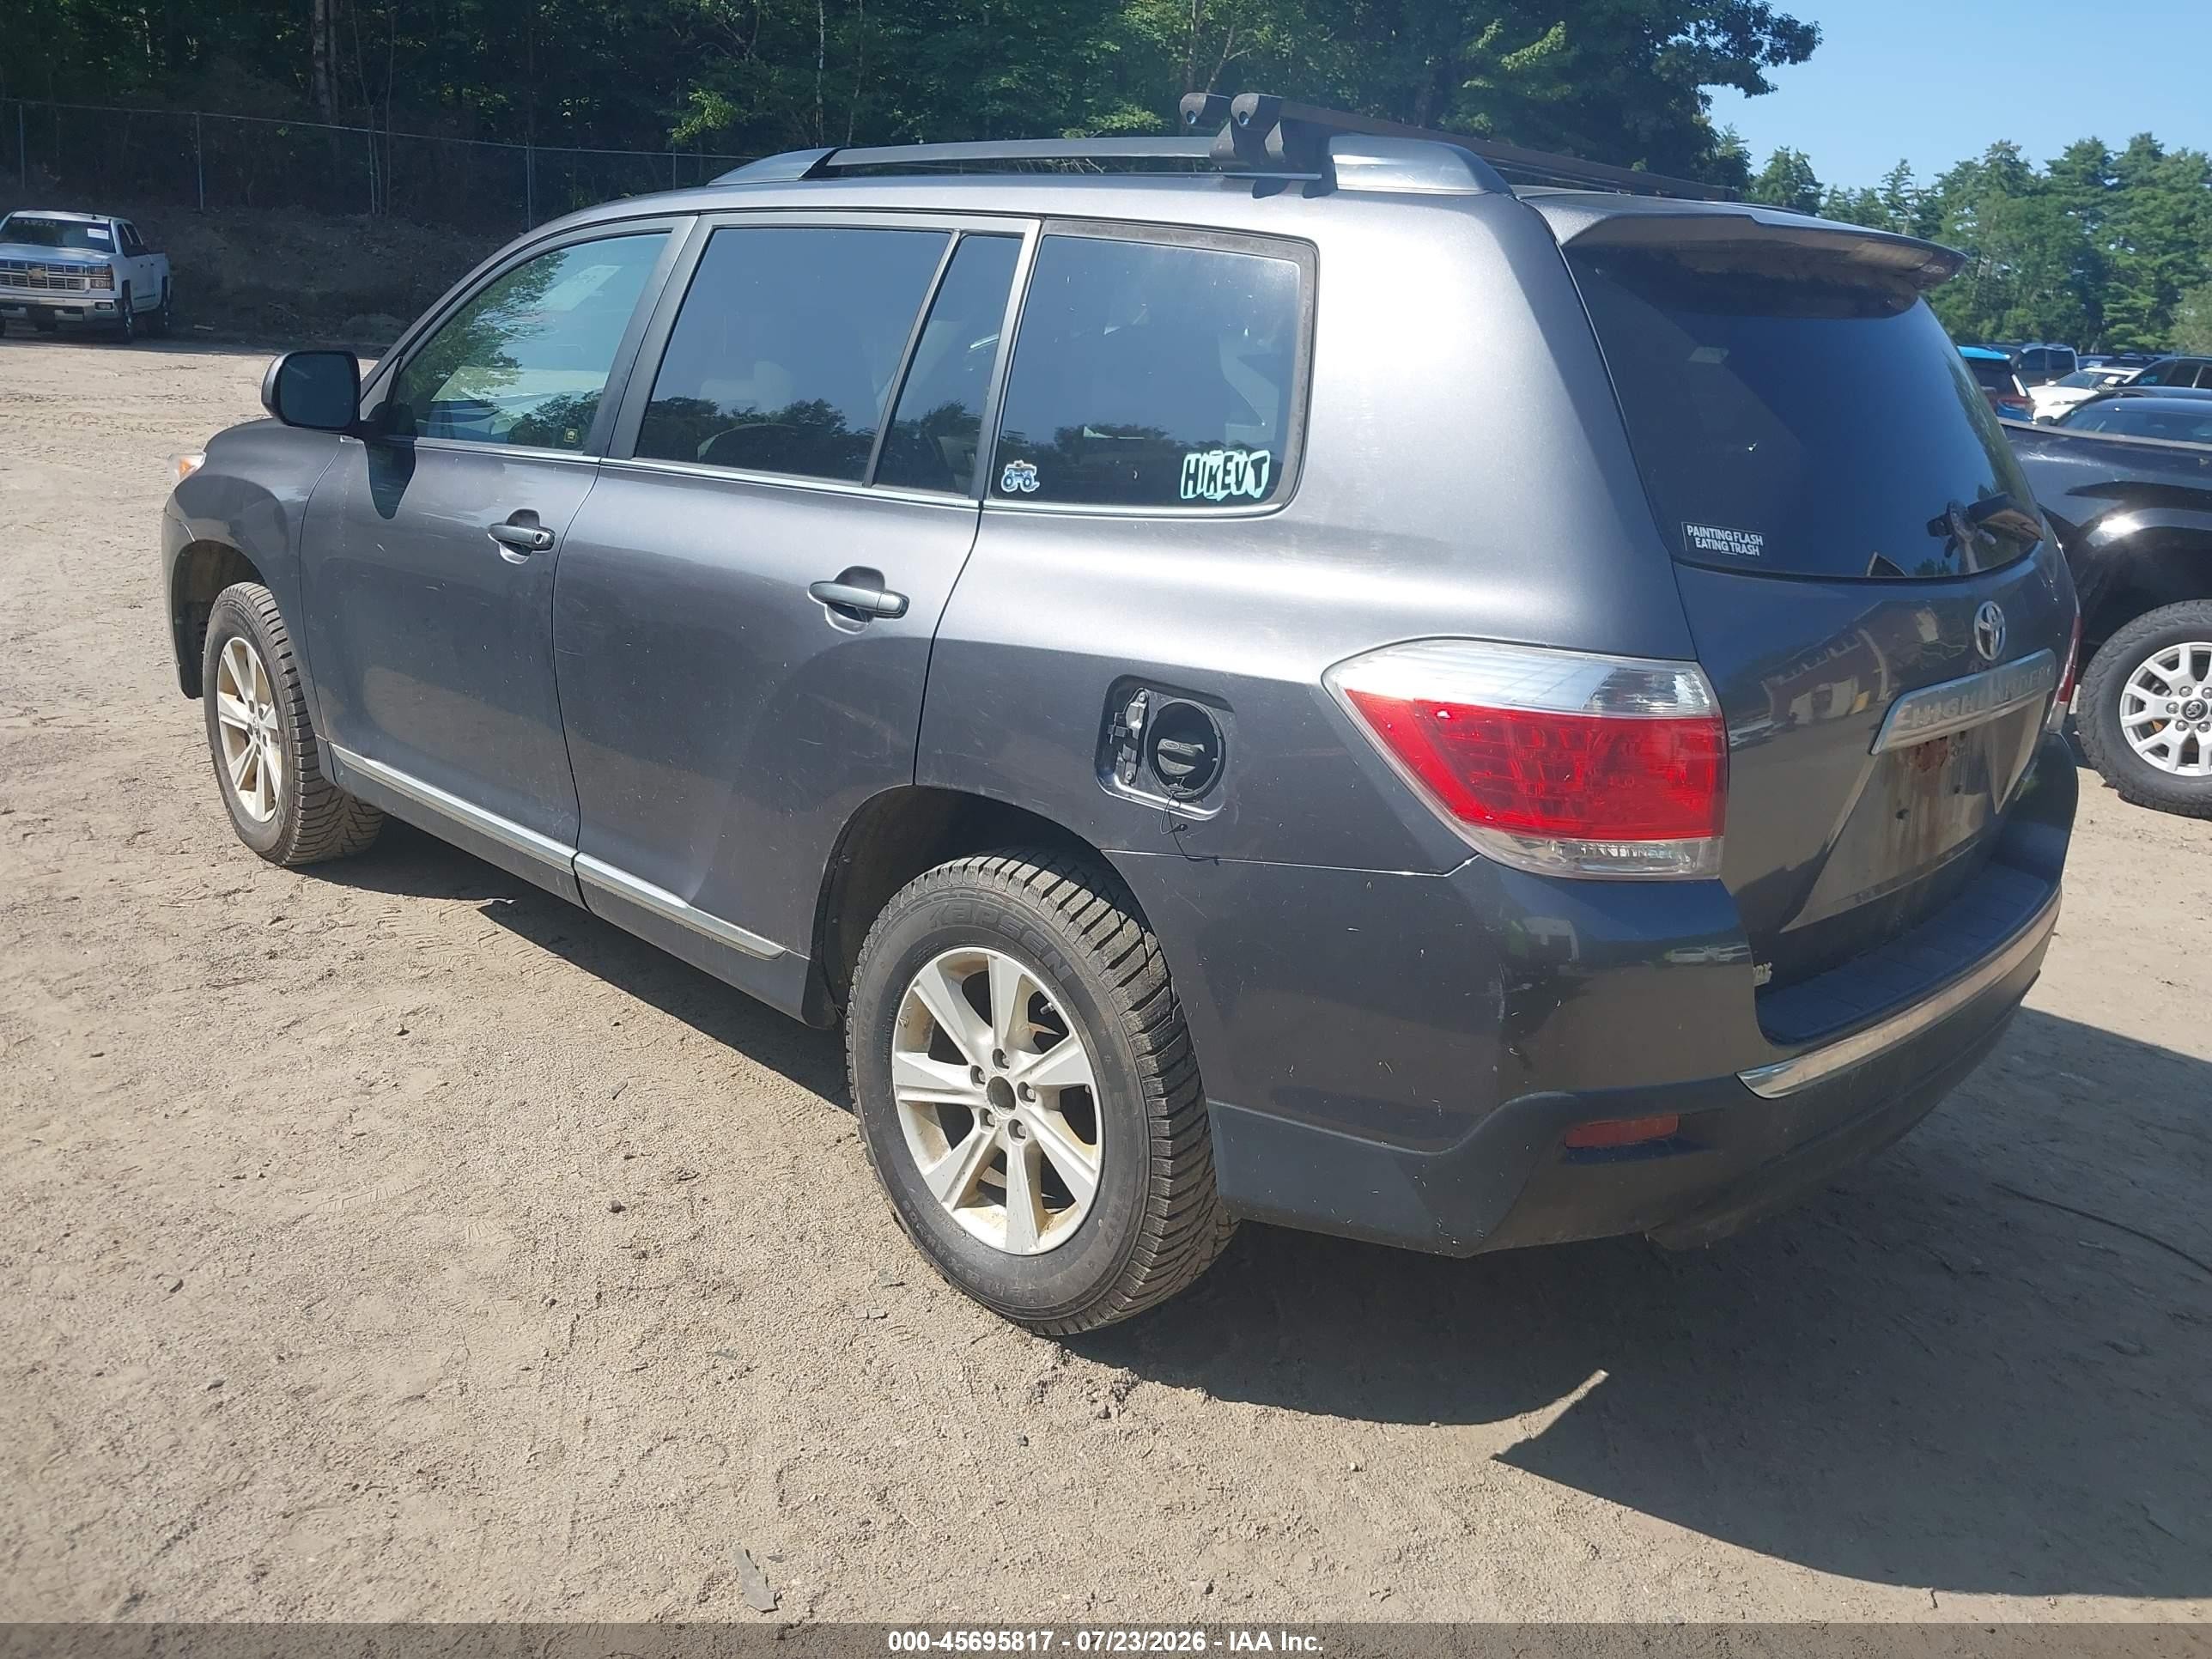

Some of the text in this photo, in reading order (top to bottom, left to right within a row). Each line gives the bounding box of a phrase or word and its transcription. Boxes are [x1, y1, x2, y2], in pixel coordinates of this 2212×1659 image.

[1686, 525, 1764, 546] PAINTING FLASH
[1695, 537, 1760, 556] EATING TRASH
[1911, 664, 2053, 728] HIGHNDER
